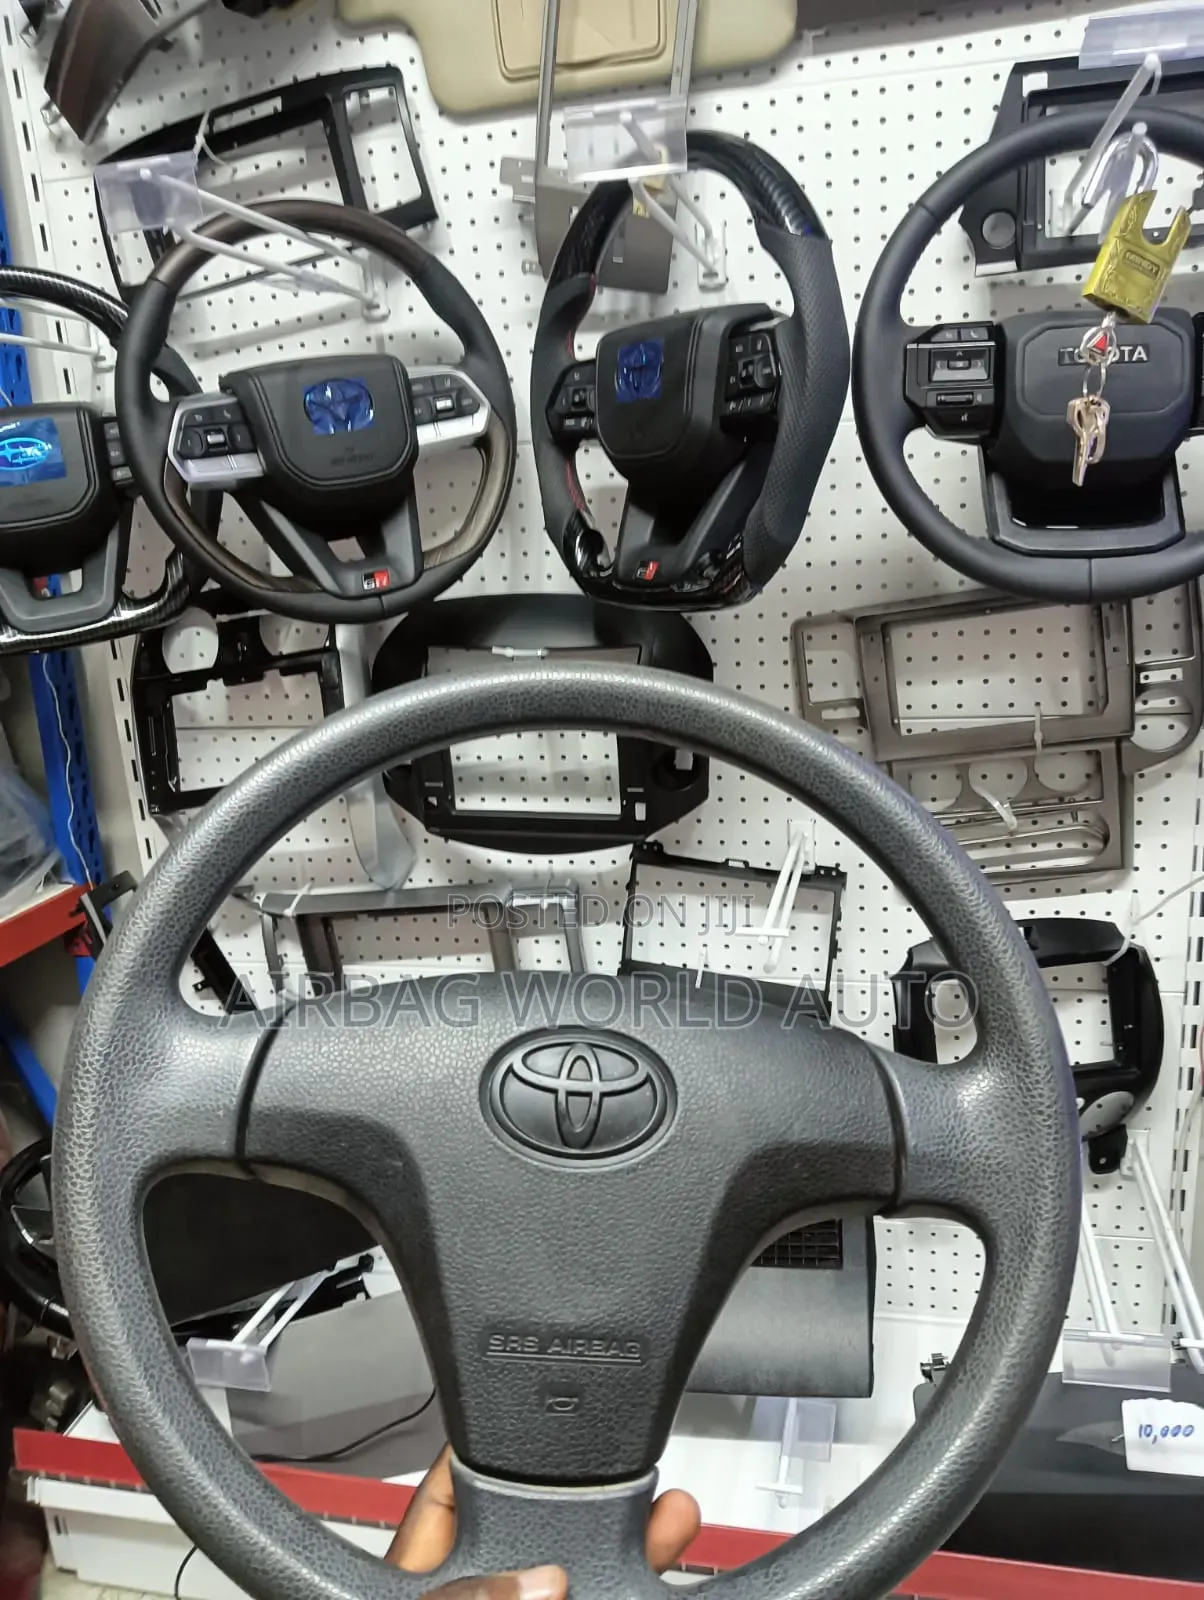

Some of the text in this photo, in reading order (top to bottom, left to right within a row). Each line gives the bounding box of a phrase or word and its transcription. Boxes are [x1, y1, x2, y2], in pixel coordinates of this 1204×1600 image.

[1060, 345, 1148, 364] TOOTA
[489, 1334, 640, 1358] SRS AIRBAG
[1138, 1423, 1194, 1445] 10,000
